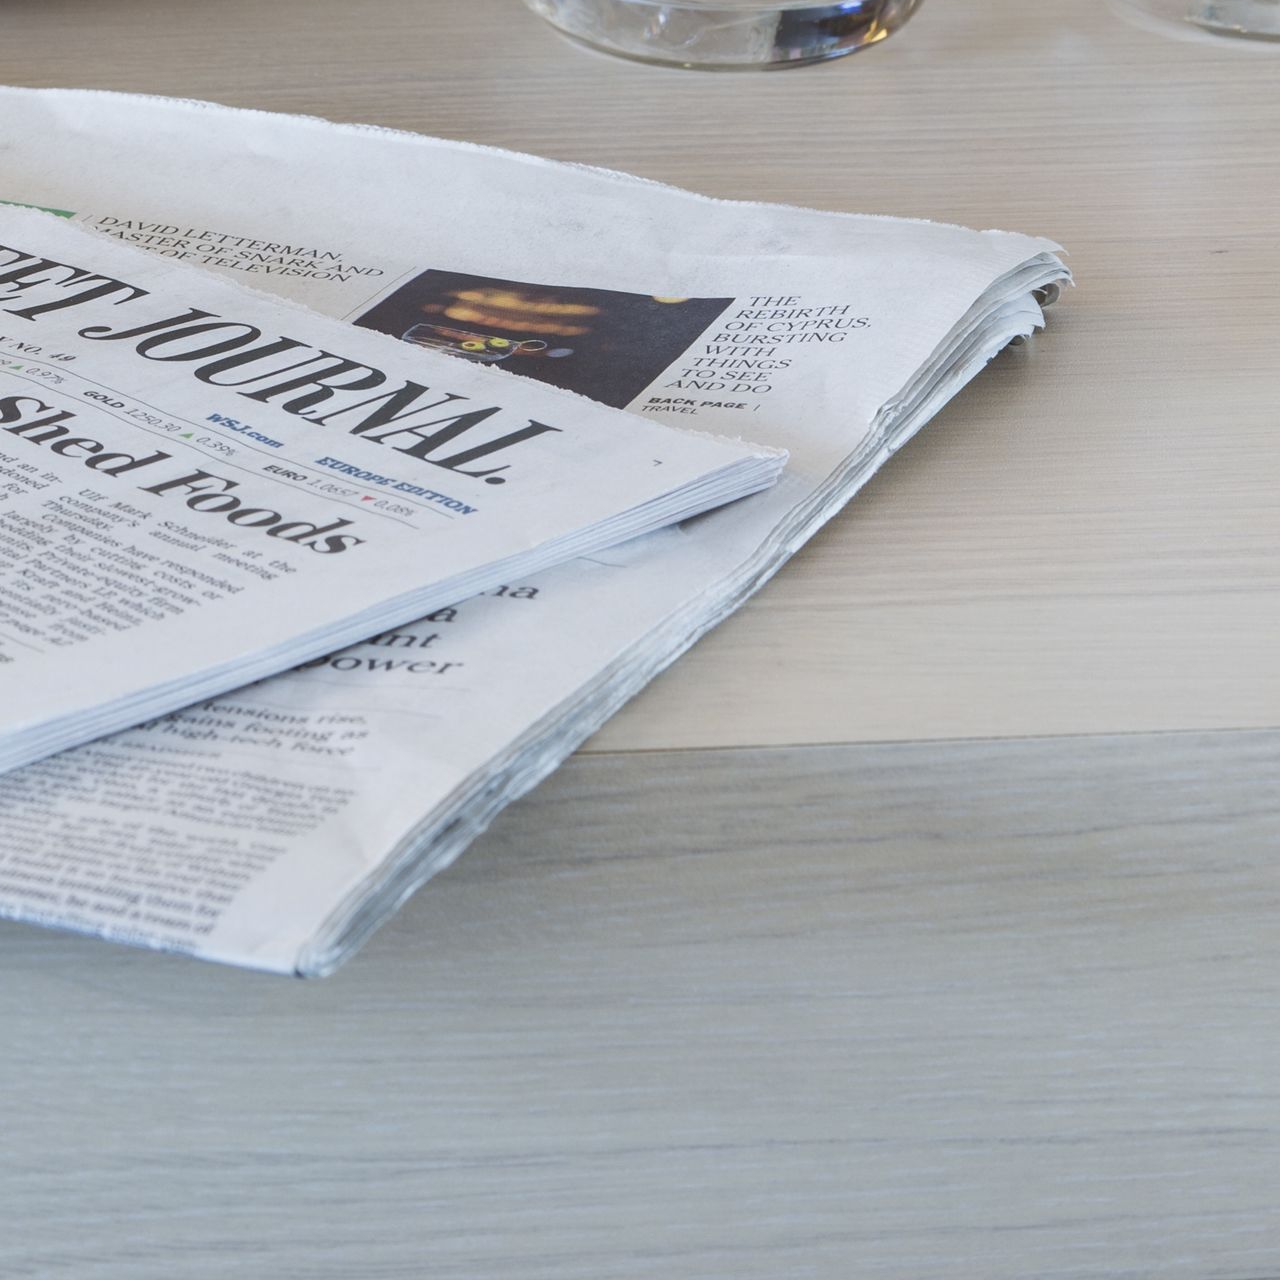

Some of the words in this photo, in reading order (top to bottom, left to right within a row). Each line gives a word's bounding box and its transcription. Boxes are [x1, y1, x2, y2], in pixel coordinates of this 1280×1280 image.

[98, 216, 180, 234] DAVID
[184, 228, 345, 262] LETTERMAN,
[159, 248, 198, 261] OF
[202, 255, 353, 283] TELEVISION
[195, 243, 234, 254] OF
[232, 249, 324, 271] SNARK
[325, 263, 385, 277] AND
[750, 296, 802, 307] THE
[736, 304, 852, 320] REBIRTH
[724, 321, 764, 332] OF
[711, 331, 848, 345] BURSTING
[16, 342, 43, 355] NO.
[49, 353, 77, 362] 49
[704, 344, 777, 357] WITH
[692, 357, 793, 369] THINGS
[681, 368, 718, 379] TO
[720, 369, 773, 382] SEE
[663, 380, 725, 391] AND
[729, 383, 773, 394] DO
[78, 308, 557, 484] JOURNAL.
[83, 390, 126, 409] GOLD
[647, 397, 696, 407] BACK
[700, 400, 748, 411] PAGE
[641, 405, 699, 415] TRAVEL
[205, 413, 285, 449] WSJ.com
[262, 464, 308, 481] EURO
[314, 456, 397, 486] EUROPE
[391, 481, 478, 515] EDITION
[137, 469, 364, 553] Foods
